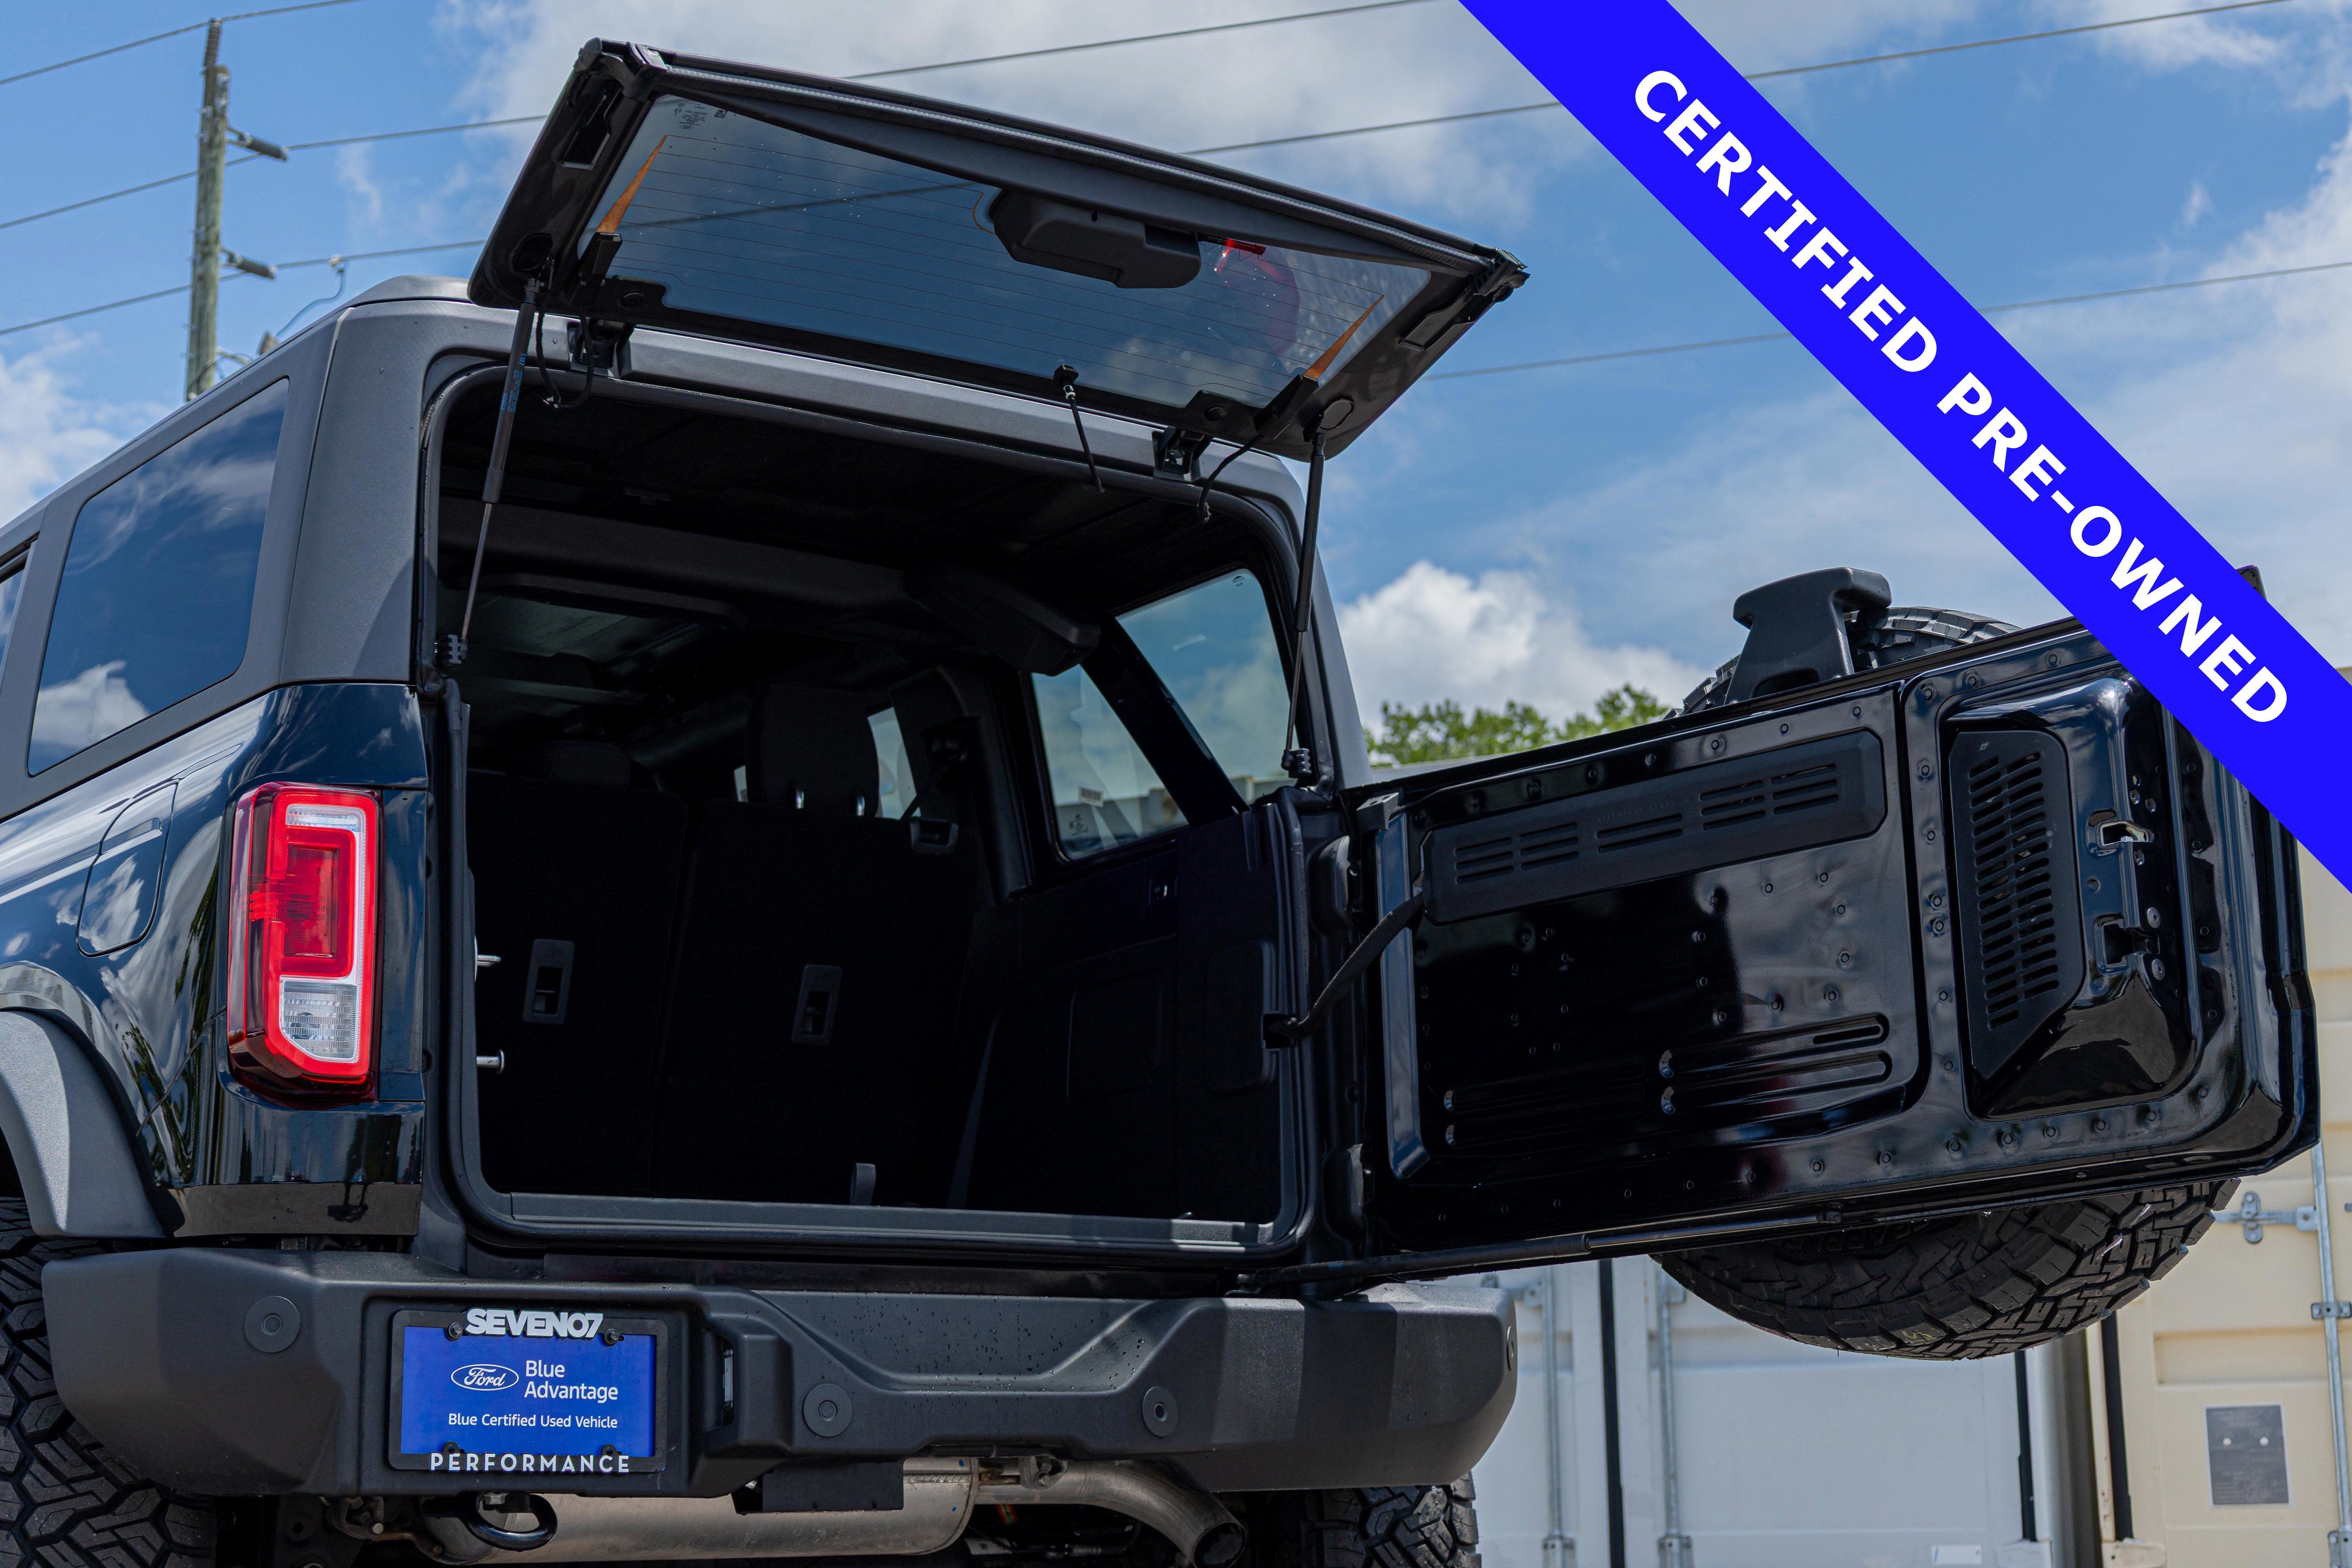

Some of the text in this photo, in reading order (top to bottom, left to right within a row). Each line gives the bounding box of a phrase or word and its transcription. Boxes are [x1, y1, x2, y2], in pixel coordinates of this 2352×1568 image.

[463, 1366, 507, 1388] Ford
[526, 1360, 565, 1378] Blue
[524, 1381, 618, 1403] Advantage
[449, 1413, 617, 1428] Blue Certified Used Vehicle
[431, 1453, 629, 1472] PERFORMANCE
